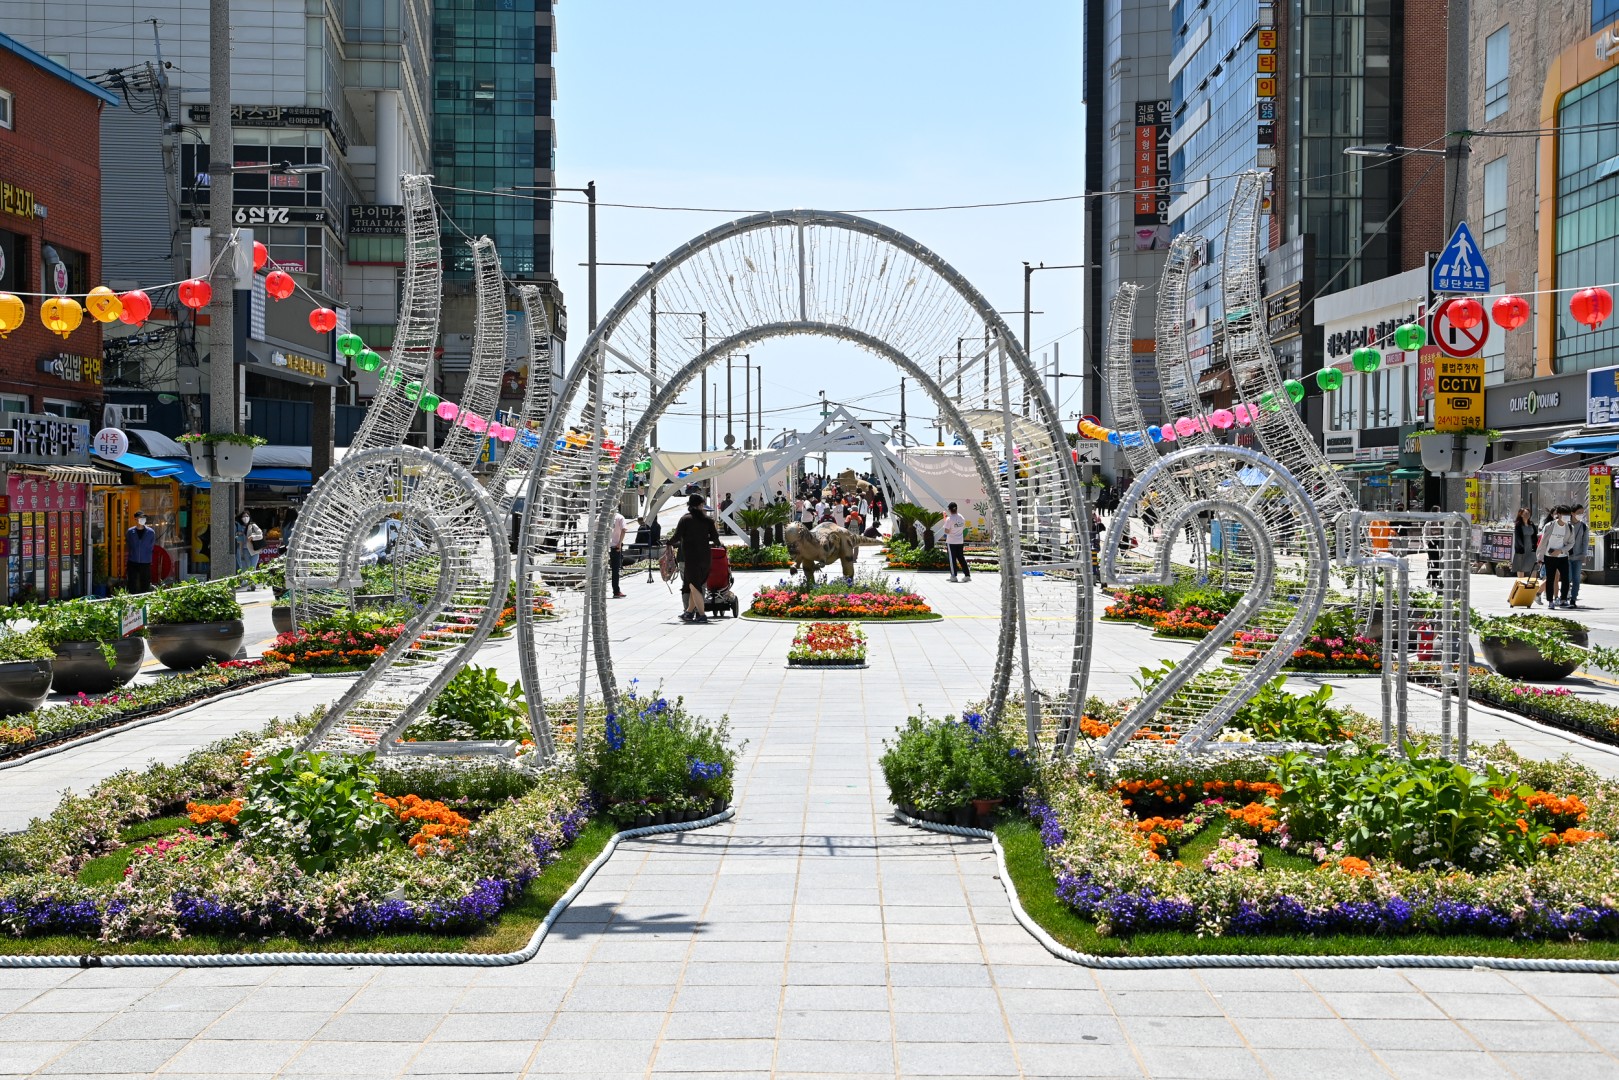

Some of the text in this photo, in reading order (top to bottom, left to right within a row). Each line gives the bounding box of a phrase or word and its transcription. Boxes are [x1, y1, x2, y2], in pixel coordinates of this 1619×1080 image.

[1138, 105, 1155, 113] 진료
[315, 213, 325, 221] 2F
[1438, 278, 1486, 290] 횡단보도
[83, 357, 101, 385] 라면
[1441, 363, 1479, 373] 불법주정차
[1441, 378, 1478, 391] CCTV
[1510, 392, 1559, 412] OLIVE YOUNG
[1437, 415, 1481, 427] 24시간 단속중
[101, 433, 119, 441] 사주
[100, 444, 119, 454] 타로
[1591, 467, 1608, 475] 추천
[1590, 504, 1604, 512] 구이
[50, 530, 57, 552] 타로
[63, 530, 69, 551] 사주
[75, 530, 81, 551] 타로
[51, 573, 57, 593] 사주
